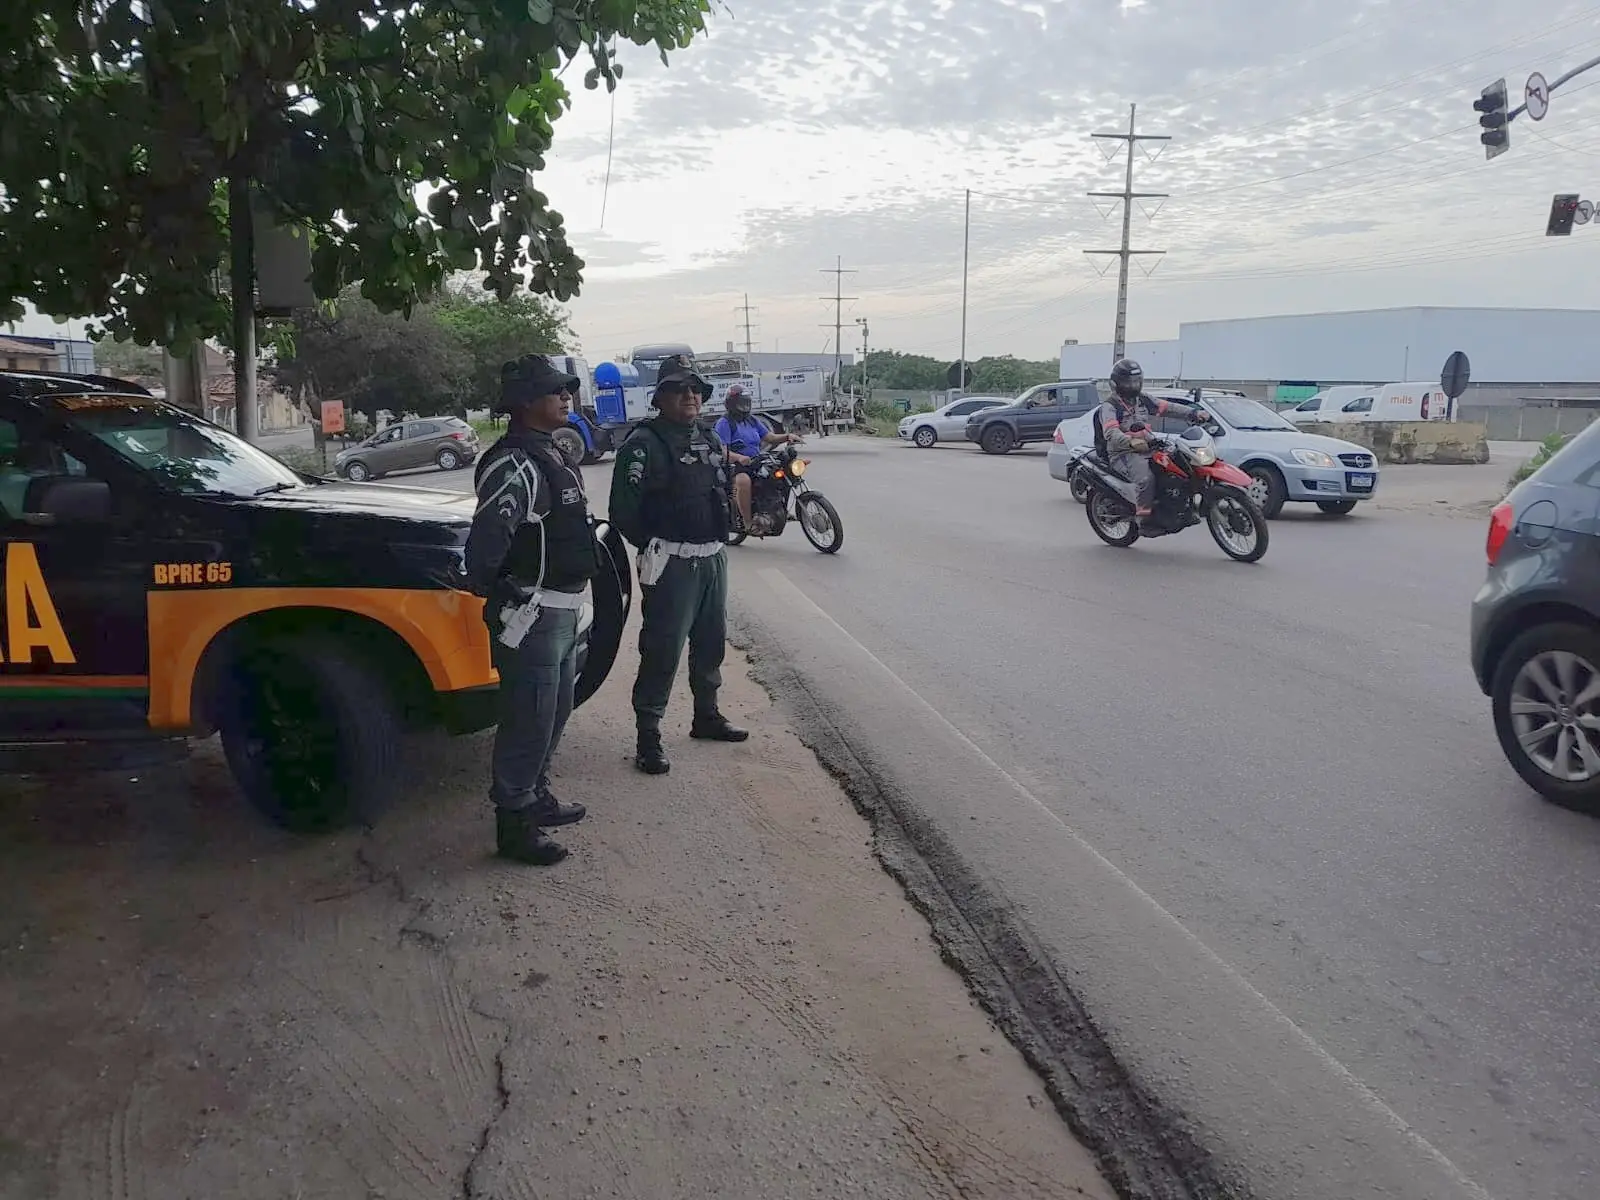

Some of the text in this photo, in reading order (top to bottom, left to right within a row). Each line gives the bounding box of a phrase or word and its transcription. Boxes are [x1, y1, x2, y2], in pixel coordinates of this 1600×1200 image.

[1390, 395, 1413, 405] mills
[154, 562, 232, 585] BPRE 65
[0, 542, 77, 663] A
